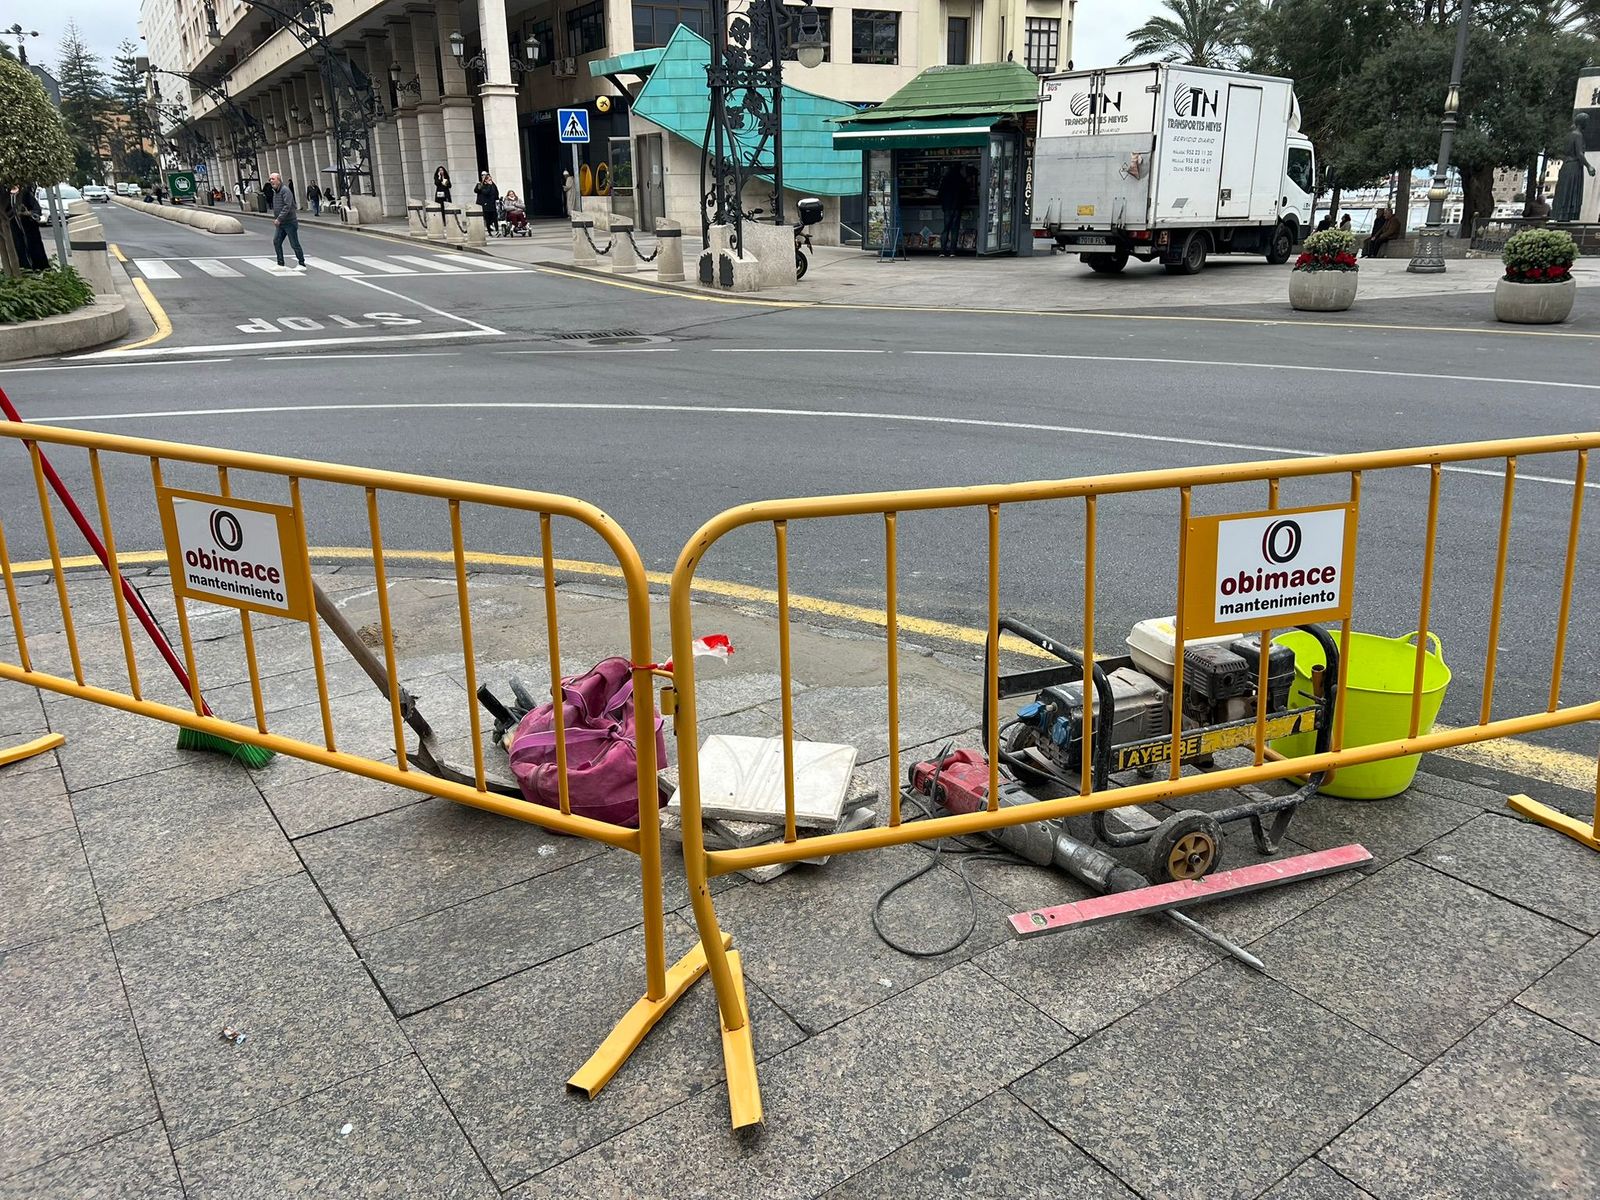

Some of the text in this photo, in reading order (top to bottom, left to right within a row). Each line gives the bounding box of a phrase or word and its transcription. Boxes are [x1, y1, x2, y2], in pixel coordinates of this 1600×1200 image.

[1065, 116, 1107, 126] TRANSPOTES
[1167, 118, 1205, 131] TRANSPORTES
[235, 311, 423, 334] STOP
[185, 547, 281, 585] obimace
[189, 573, 284, 603] mantenimiento
[1220, 565, 1336, 596] obimace
[1219, 590, 1336, 615] mantenimiento
